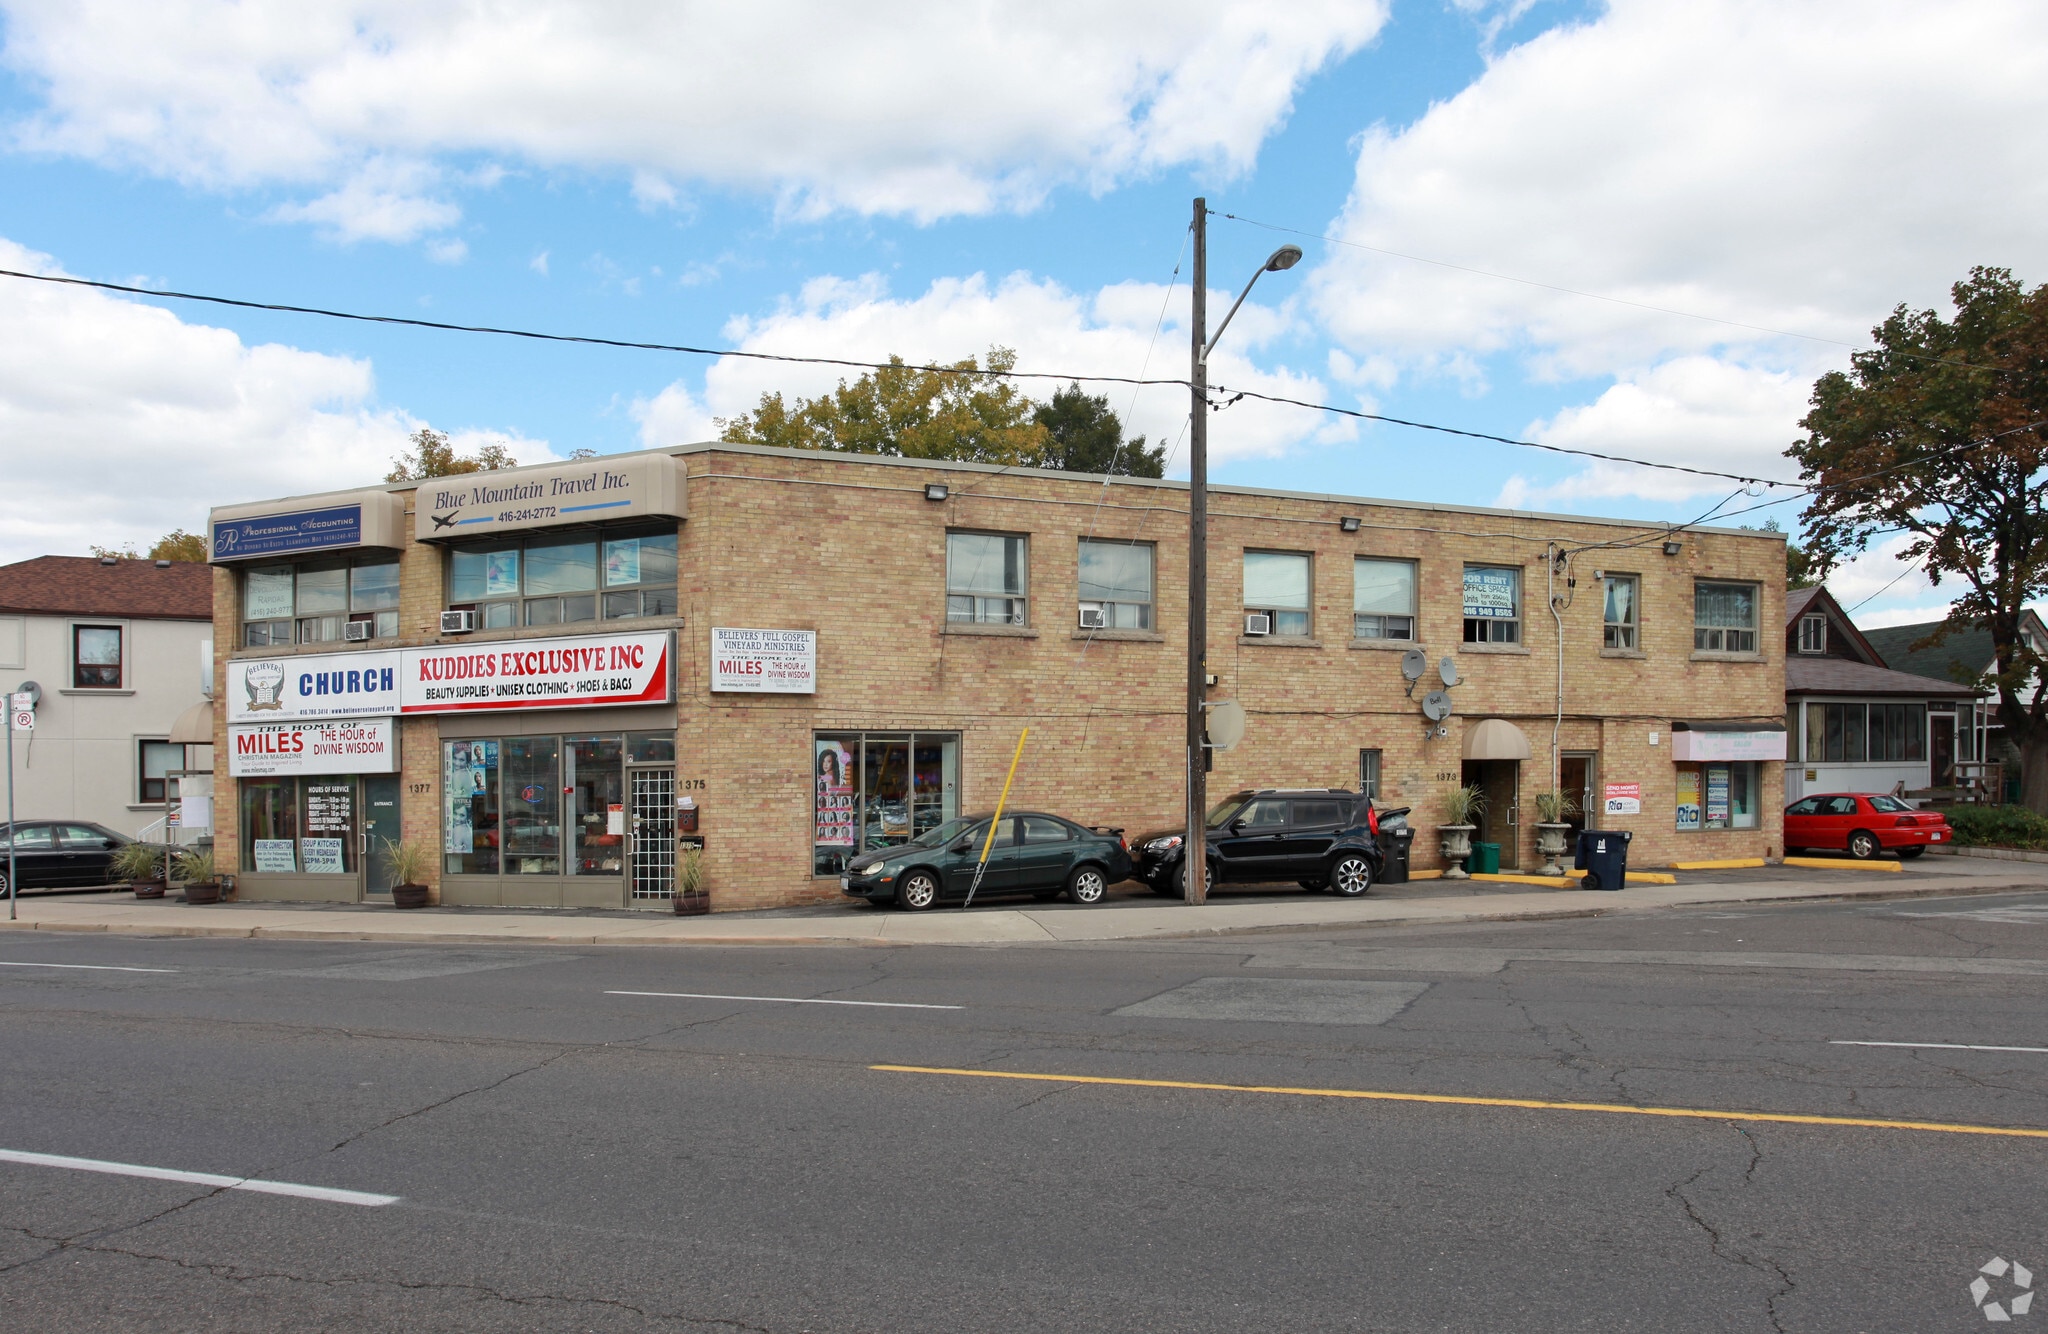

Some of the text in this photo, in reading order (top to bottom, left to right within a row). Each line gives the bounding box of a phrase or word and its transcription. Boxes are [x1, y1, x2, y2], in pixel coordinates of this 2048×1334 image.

[435, 472, 630, 510] Blue Mountain Travel Inc.
[498, 506, 556, 522] 416-241-2772
[1484, 576, 1507, 584] RENT
[1463, 584, 1486, 592] OFFICE
[1464, 595, 1478, 603] Units
[762, 633, 780, 641] FULL
[782, 633, 809, 642] GOSPEL
[723, 641, 805, 651] VINEYARD MINISTRIES
[419, 644, 644, 681] KUDDIES EXCLUSIVE INC
[720, 660, 762, 674] MILES
[249, 663, 282, 675] BELIEVERS
[300, 668, 393, 696] CHURCH
[426, 678, 632, 700] BEAUTY SUPPLIES UNISEX CLOTHING SHOES & BAGS
[1430, 696, 1441, 705] Bell
[320, 728, 377, 742] THE HOUR of
[237, 732, 304, 754] MILES
[314, 742, 384, 755] DIVINE WISDOM
[409, 784, 430, 792] 1377
[679, 780, 705, 789] 1375
[1608, 800, 1622, 810] Ria
[1677, 806, 1698, 822] Ria
